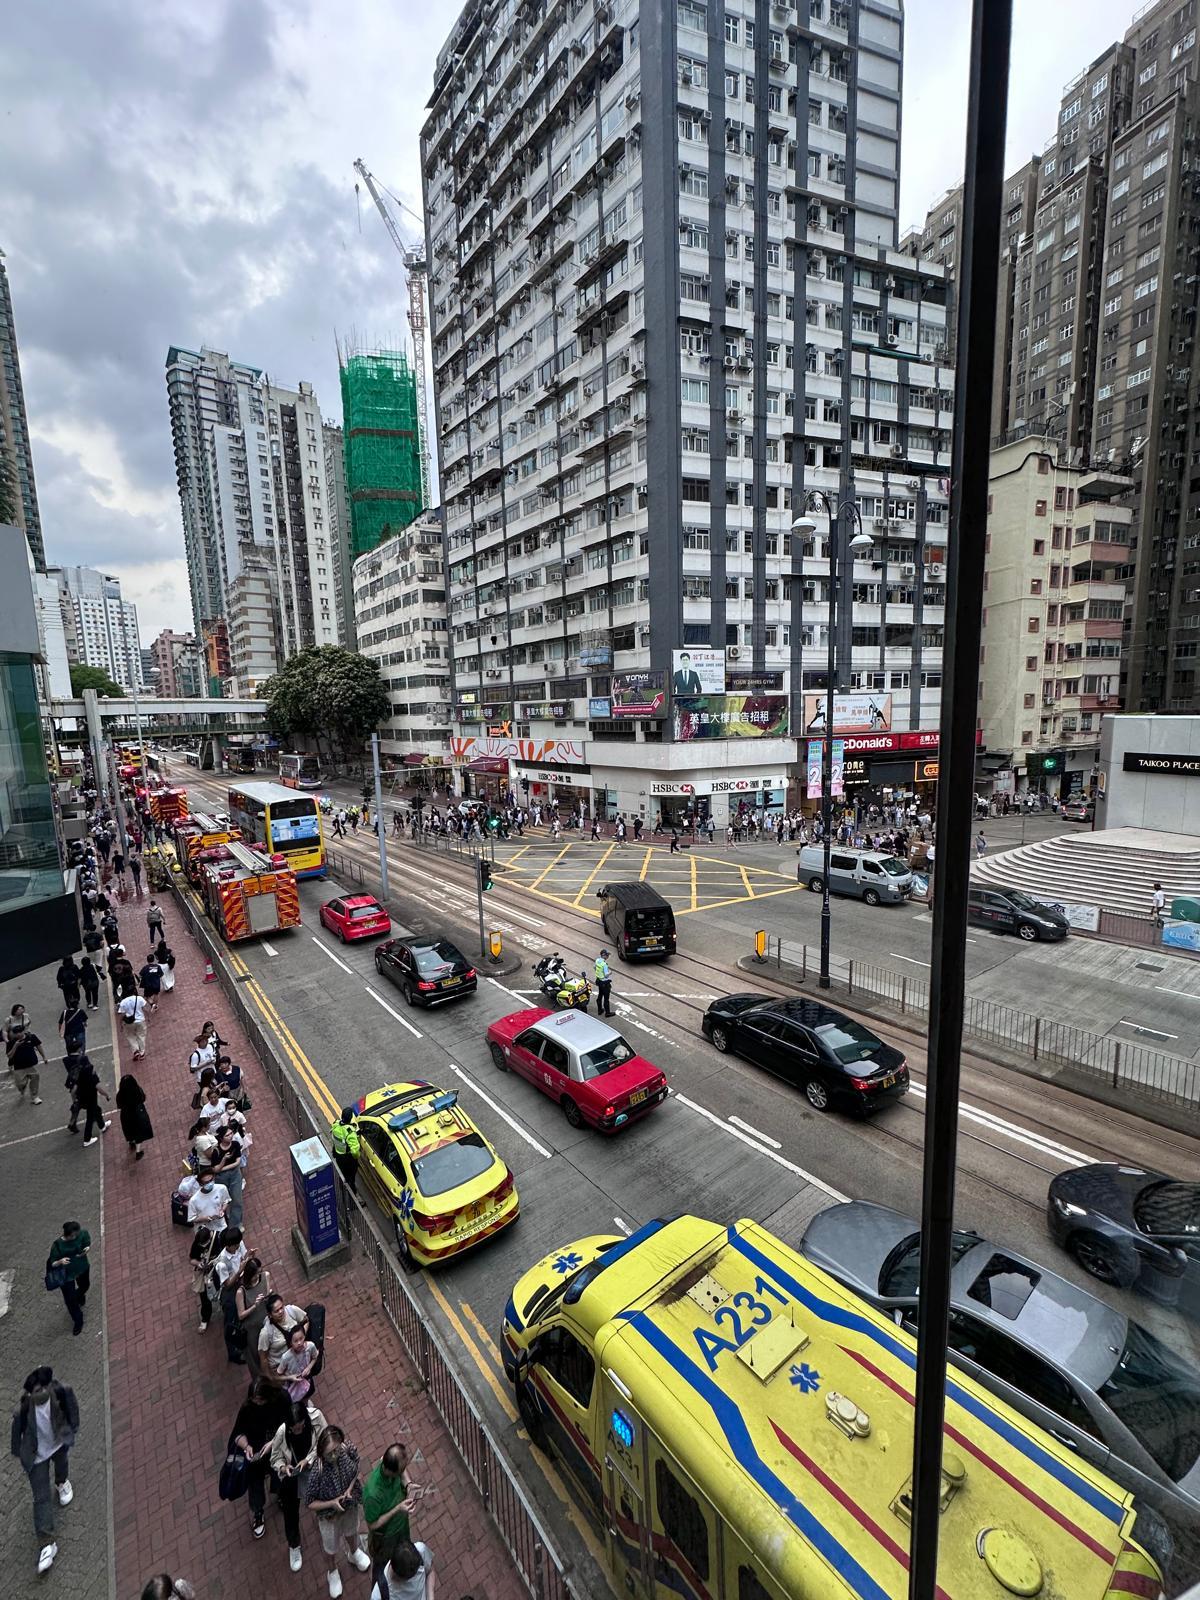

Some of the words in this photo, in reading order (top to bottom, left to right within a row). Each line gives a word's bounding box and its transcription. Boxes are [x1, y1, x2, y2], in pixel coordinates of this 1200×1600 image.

[690, 711, 769, 724] 英皇大樓廣告招租
[843, 737, 893, 750] cDonald's
[1139, 759, 1170, 768] TAIKOO
[1172, 761, 1200, 770] PLACE
[652, 784, 680, 793] HSBC
[711, 781, 736, 792] HSBC
[454, 1230, 473, 1242] RAPID
[474, 1213, 503, 1232] RESPONSE
[692, 1275, 790, 1373] A231
[608, 1429, 640, 1481] A231
